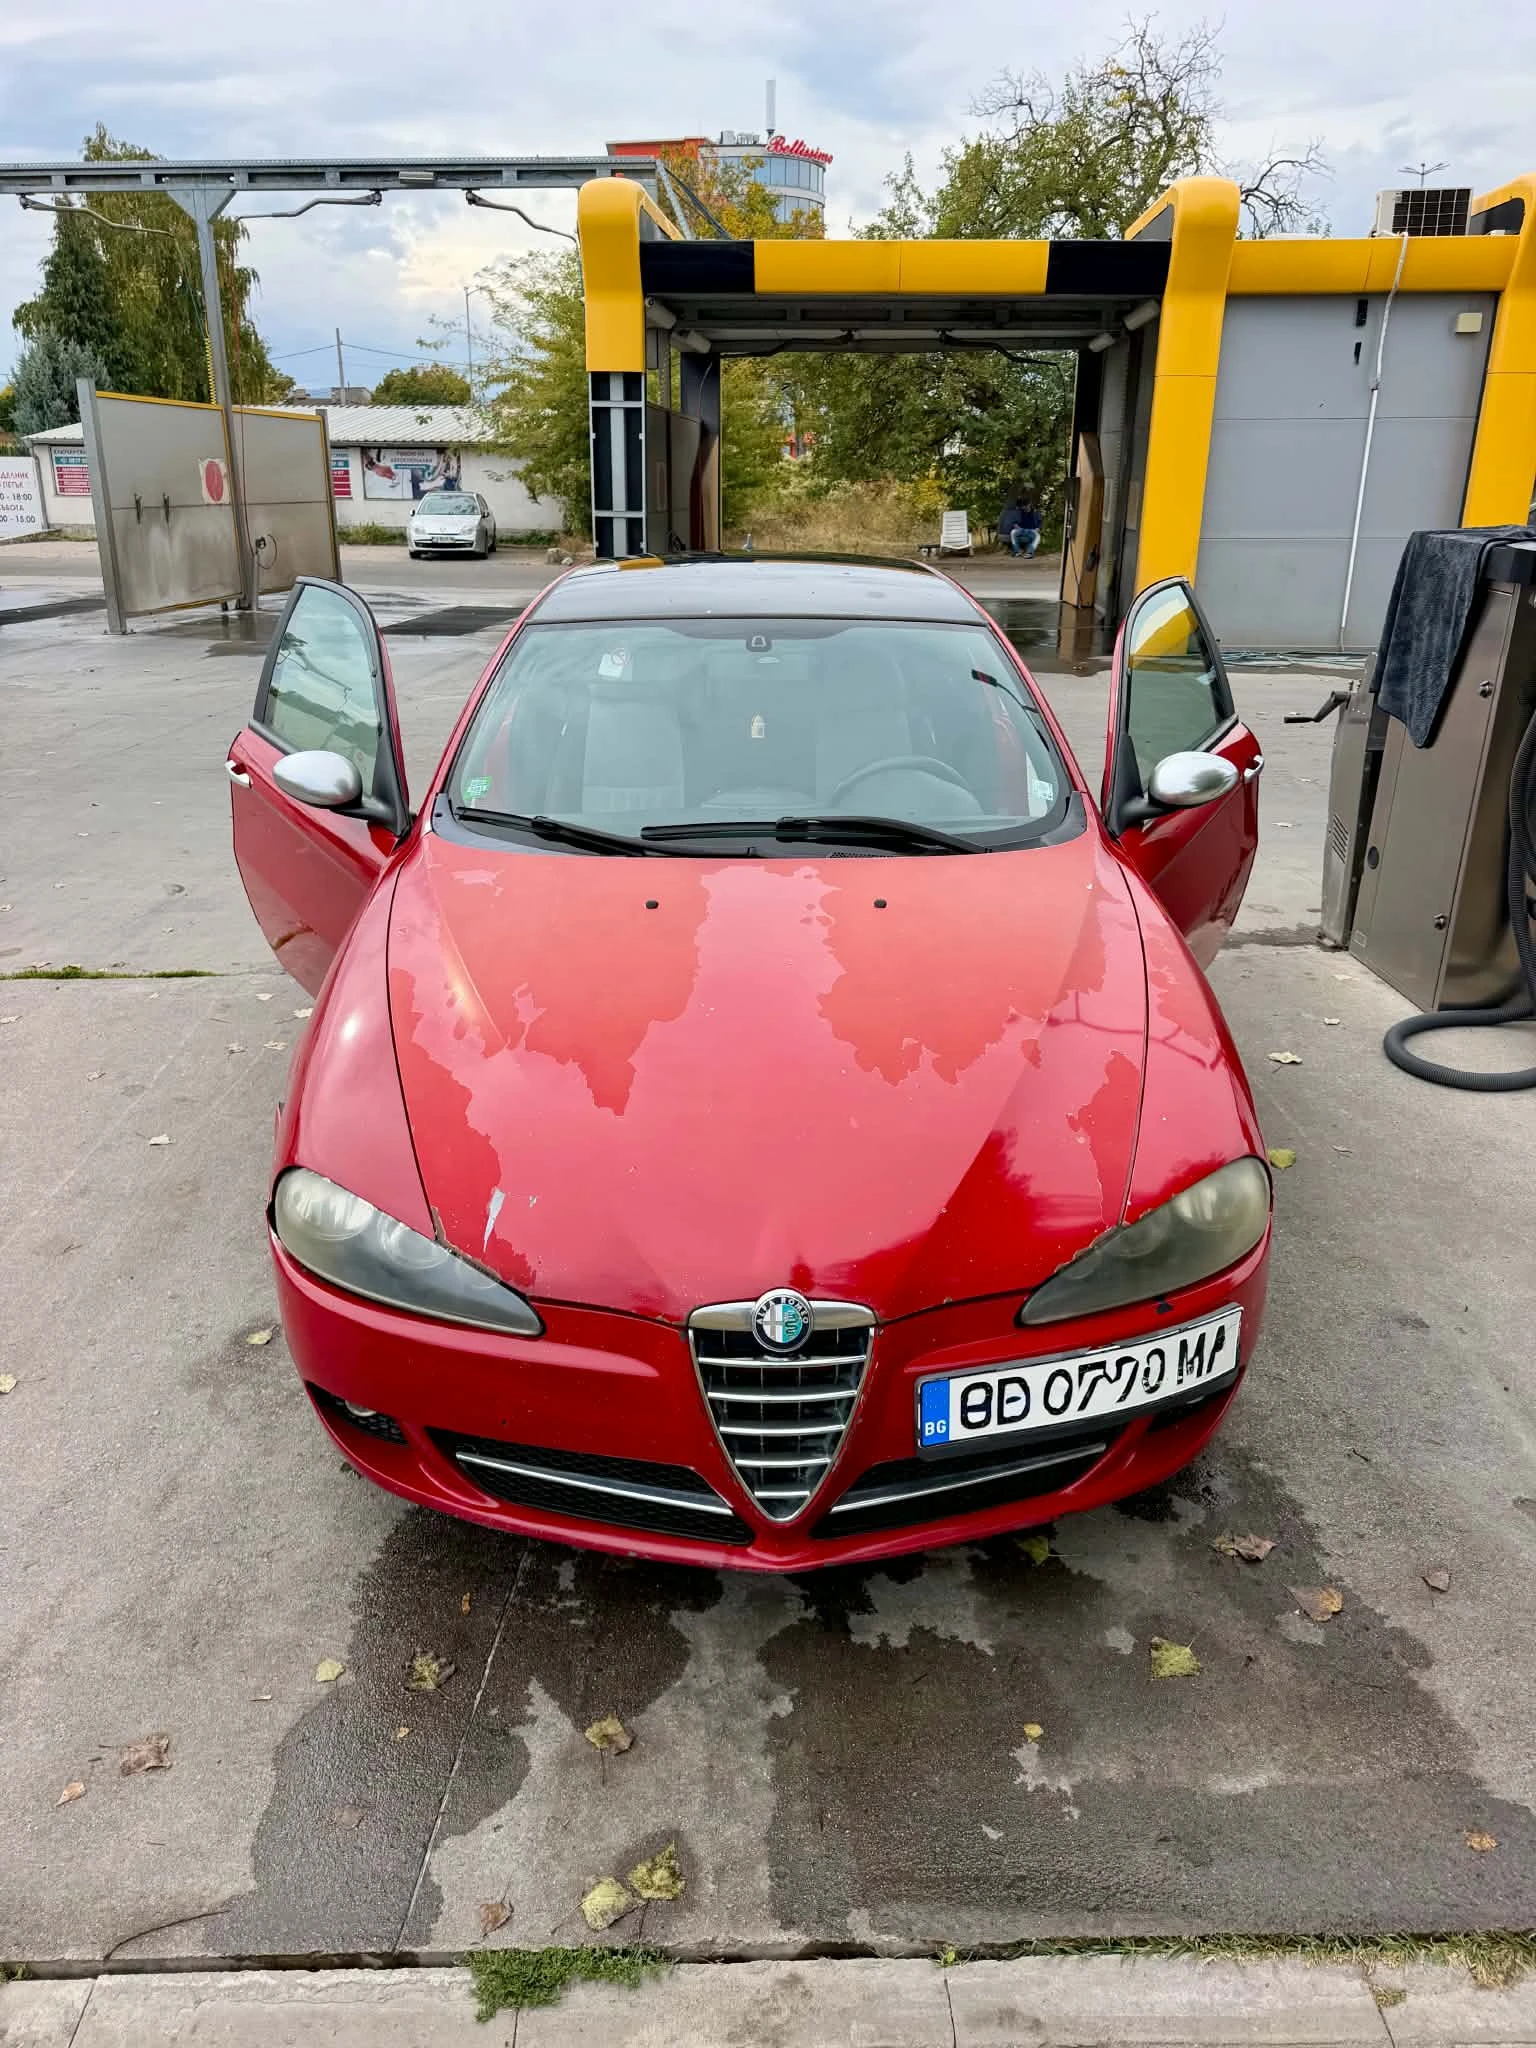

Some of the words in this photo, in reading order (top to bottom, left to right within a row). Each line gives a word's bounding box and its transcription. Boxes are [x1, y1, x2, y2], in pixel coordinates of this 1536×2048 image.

[767, 135, 834, 164] Bellissimo
[0, 471, 29, 479] ДЕЛНИК
[924, 1420, 947, 1437] BG
